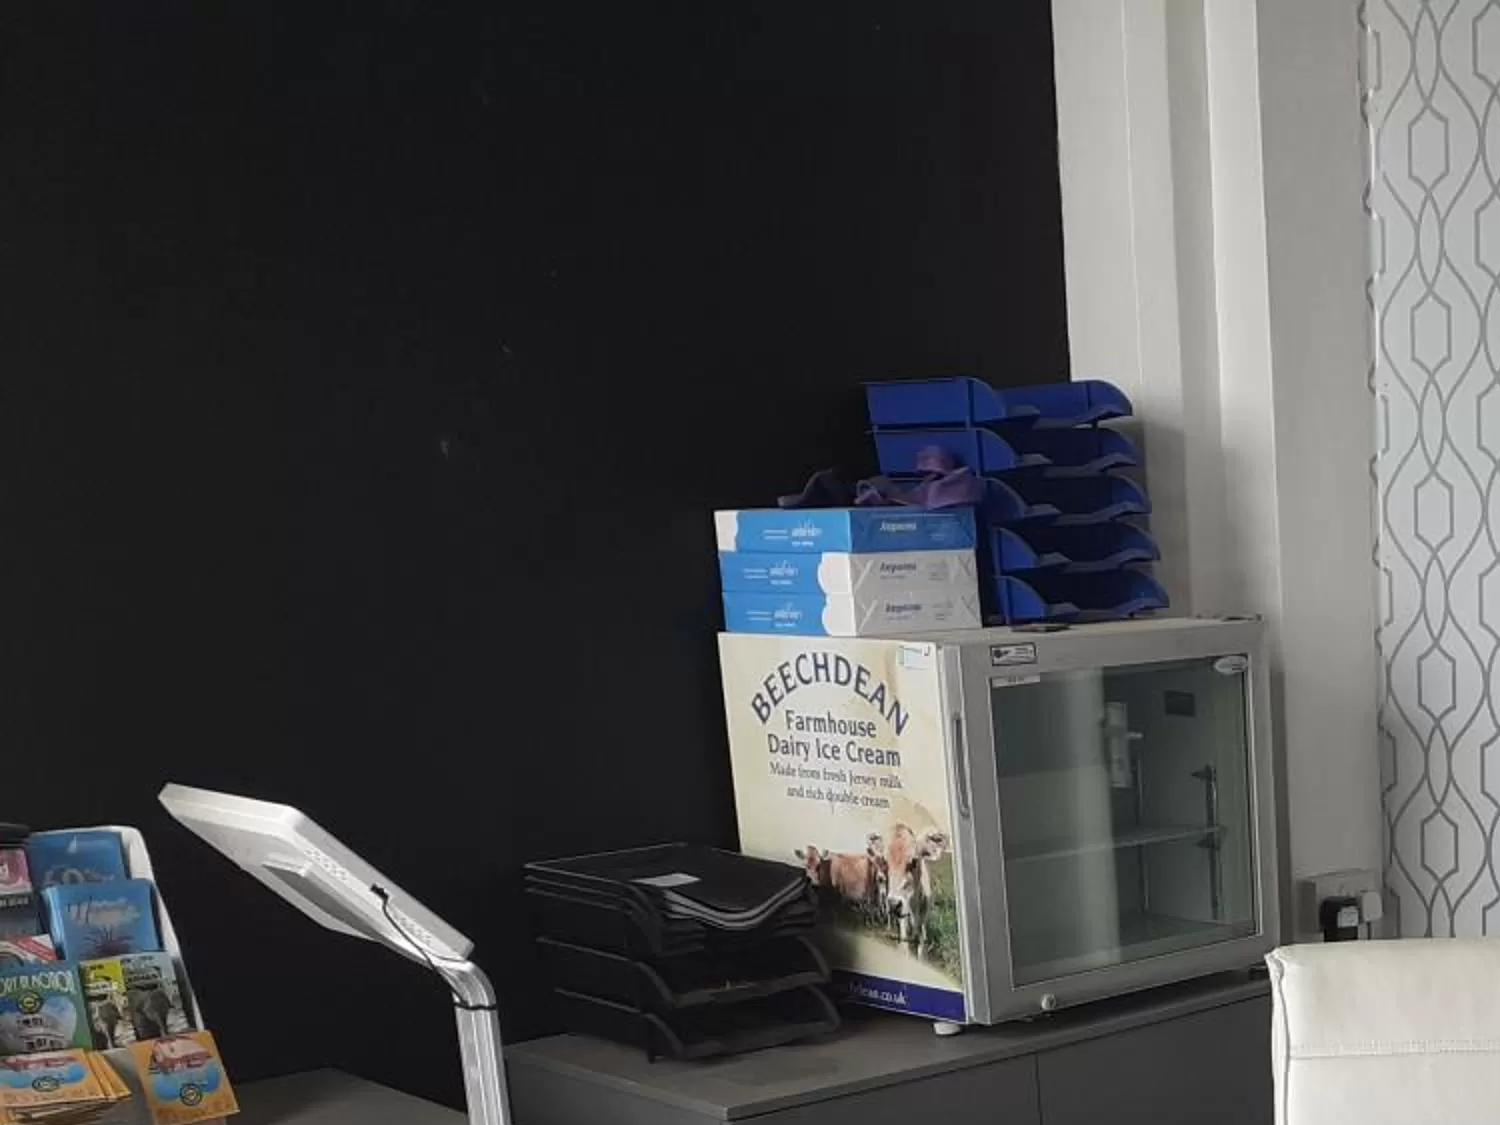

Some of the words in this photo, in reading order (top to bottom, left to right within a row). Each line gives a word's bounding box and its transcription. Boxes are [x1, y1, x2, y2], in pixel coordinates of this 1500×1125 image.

[751, 652, 910, 736] BEECHDEAN
[785, 709, 877, 739] Farmhouse
[767, 733, 811, 762] Dairy
[815, 738, 841, 760] Ice
[845, 741, 901, 767] Cream
[769, 761, 797, 777] Made
[823, 768, 847, 784] fresh
[805, 788, 825, 801] rich
[826, 788, 859, 806] double
[861, 794, 890, 809] cream
